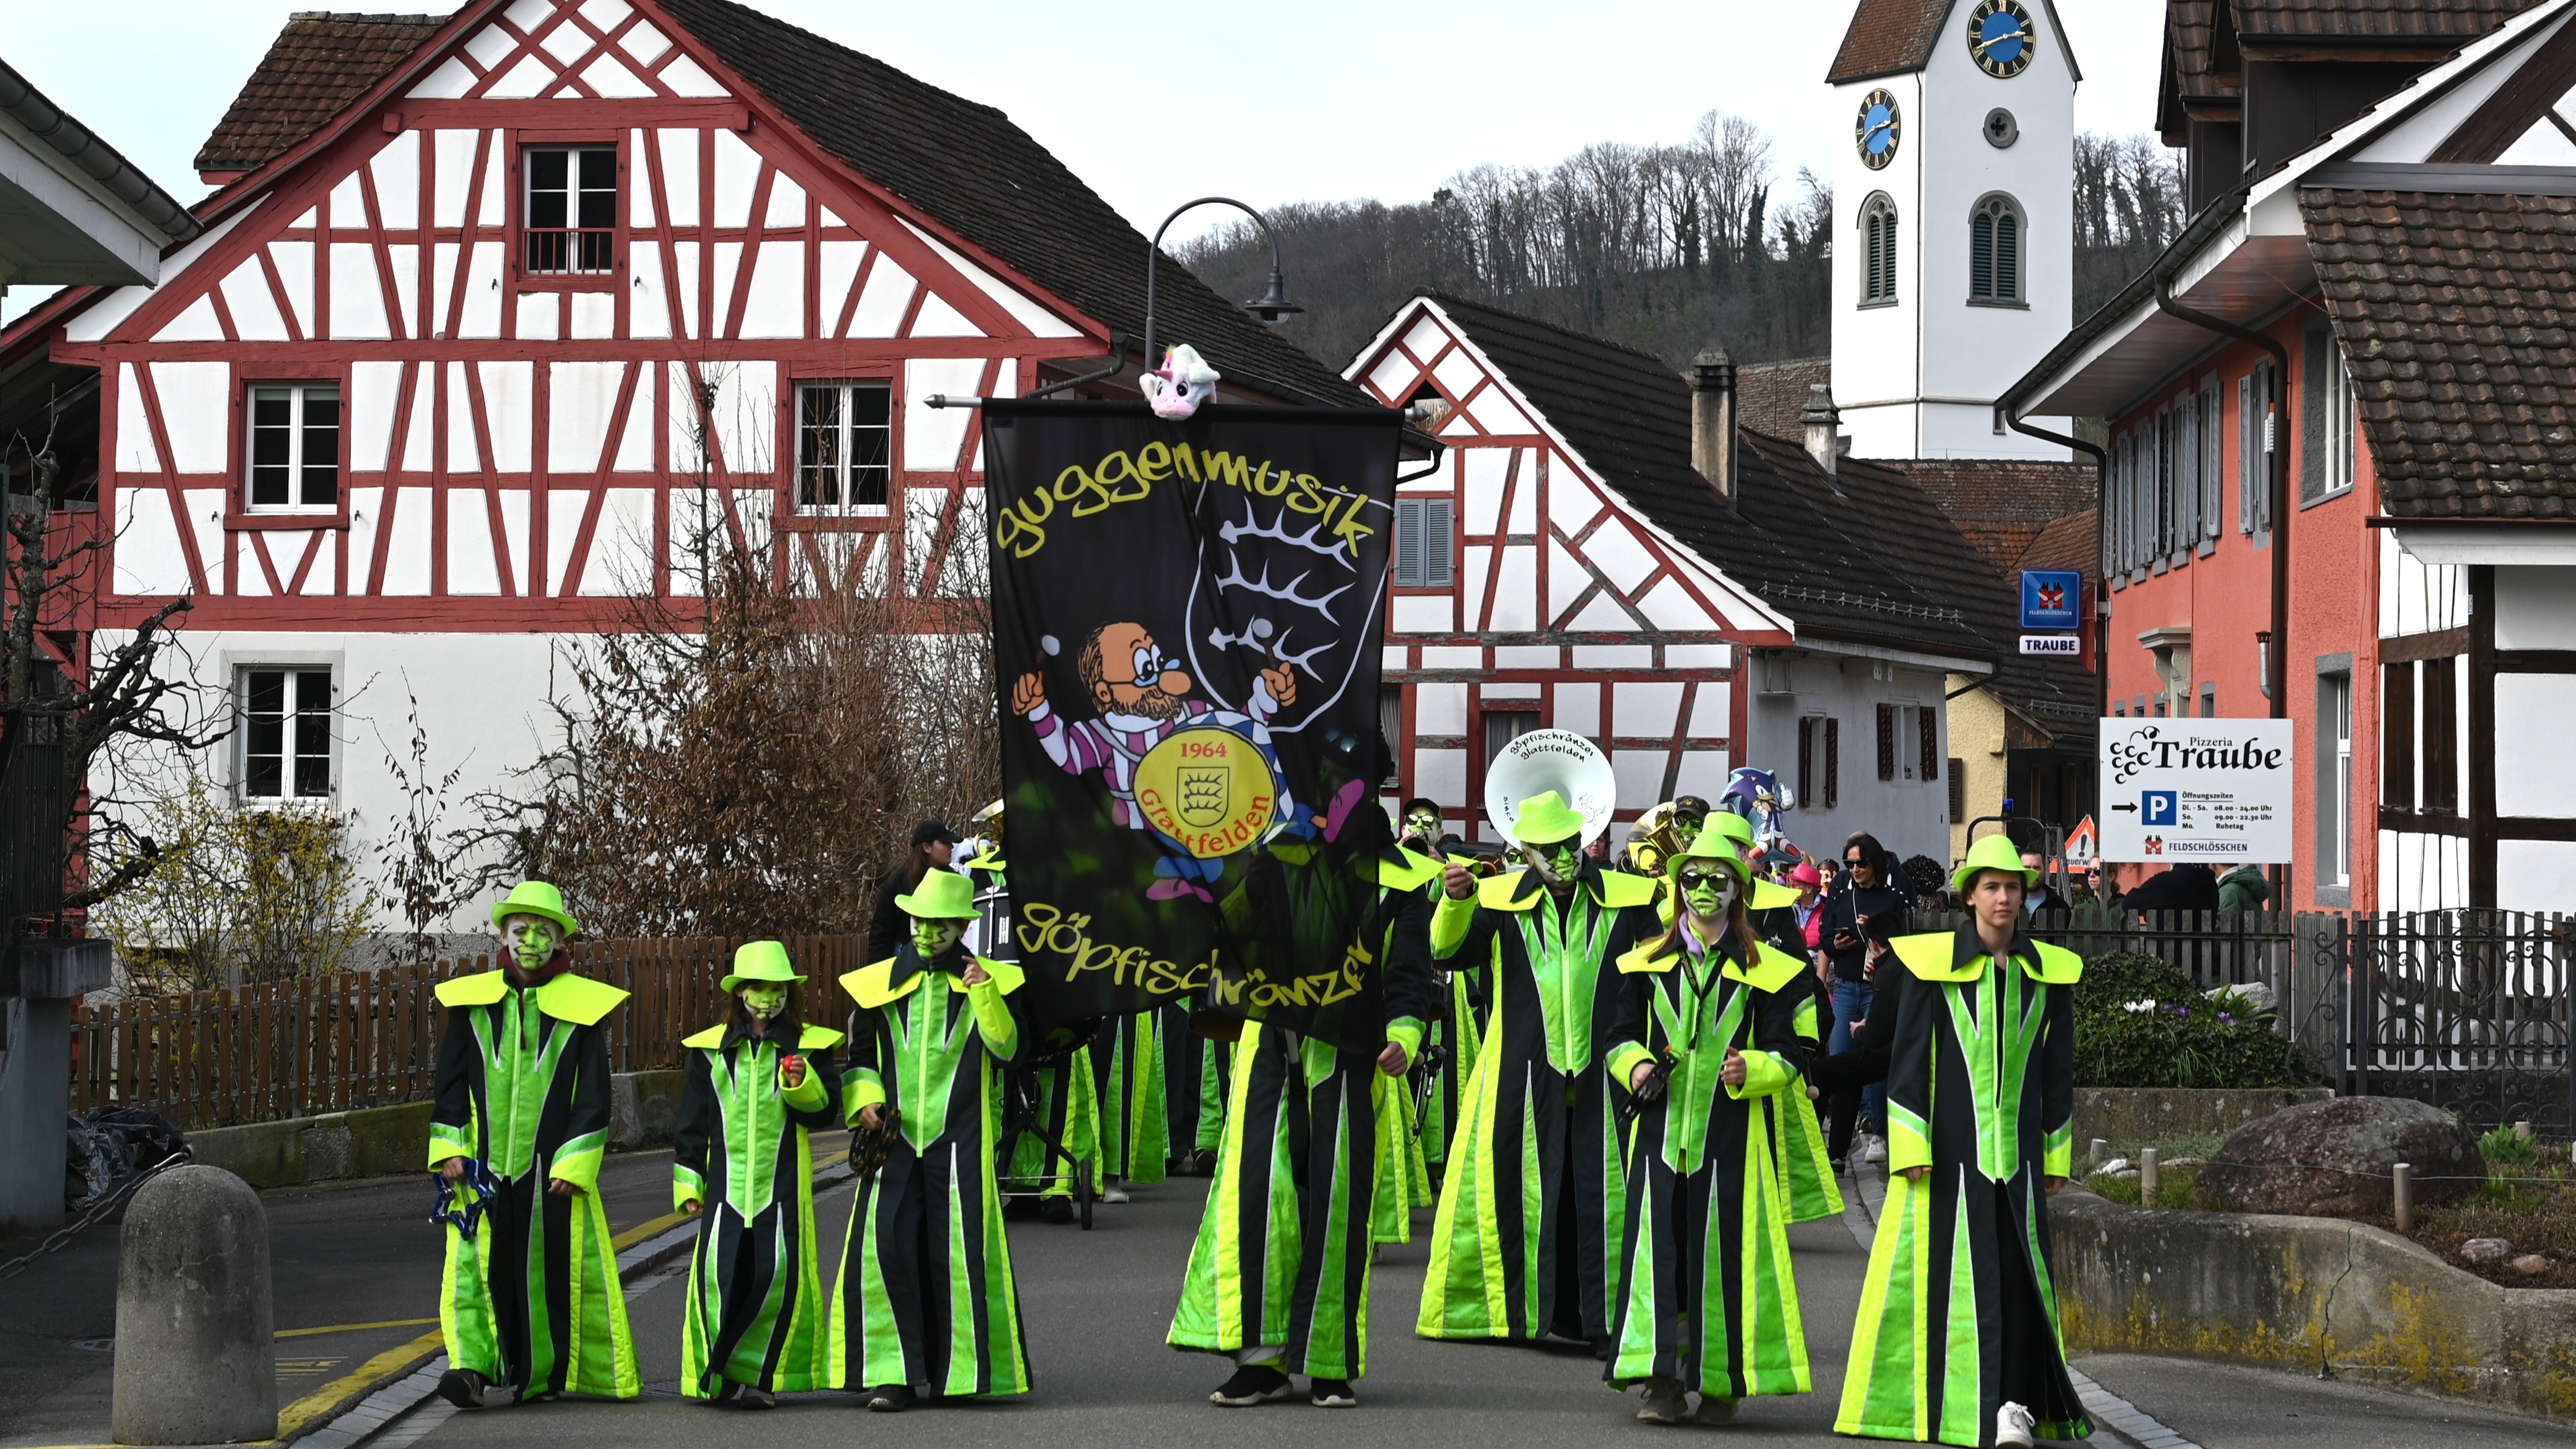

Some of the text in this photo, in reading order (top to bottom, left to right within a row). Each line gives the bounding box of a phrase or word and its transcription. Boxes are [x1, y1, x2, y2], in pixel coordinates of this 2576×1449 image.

[997, 441, 1374, 558] guggenmusik
[2025, 640, 2075, 651] TRAUBE
[2190, 737, 2233, 747] Pizzeria
[1180, 741, 1227, 758] 1964
[2151, 737, 2283, 770] Traube
[2182, 790, 2233, 800] Öffnungszeiten
[2150, 795, 2168, 821] P
[1140, 789, 1270, 854] Glattfelden
[2216, 822, 2244, 831] Ruhetag
[2169, 841, 2248, 852] FELDSCHLÖSSCHEN
